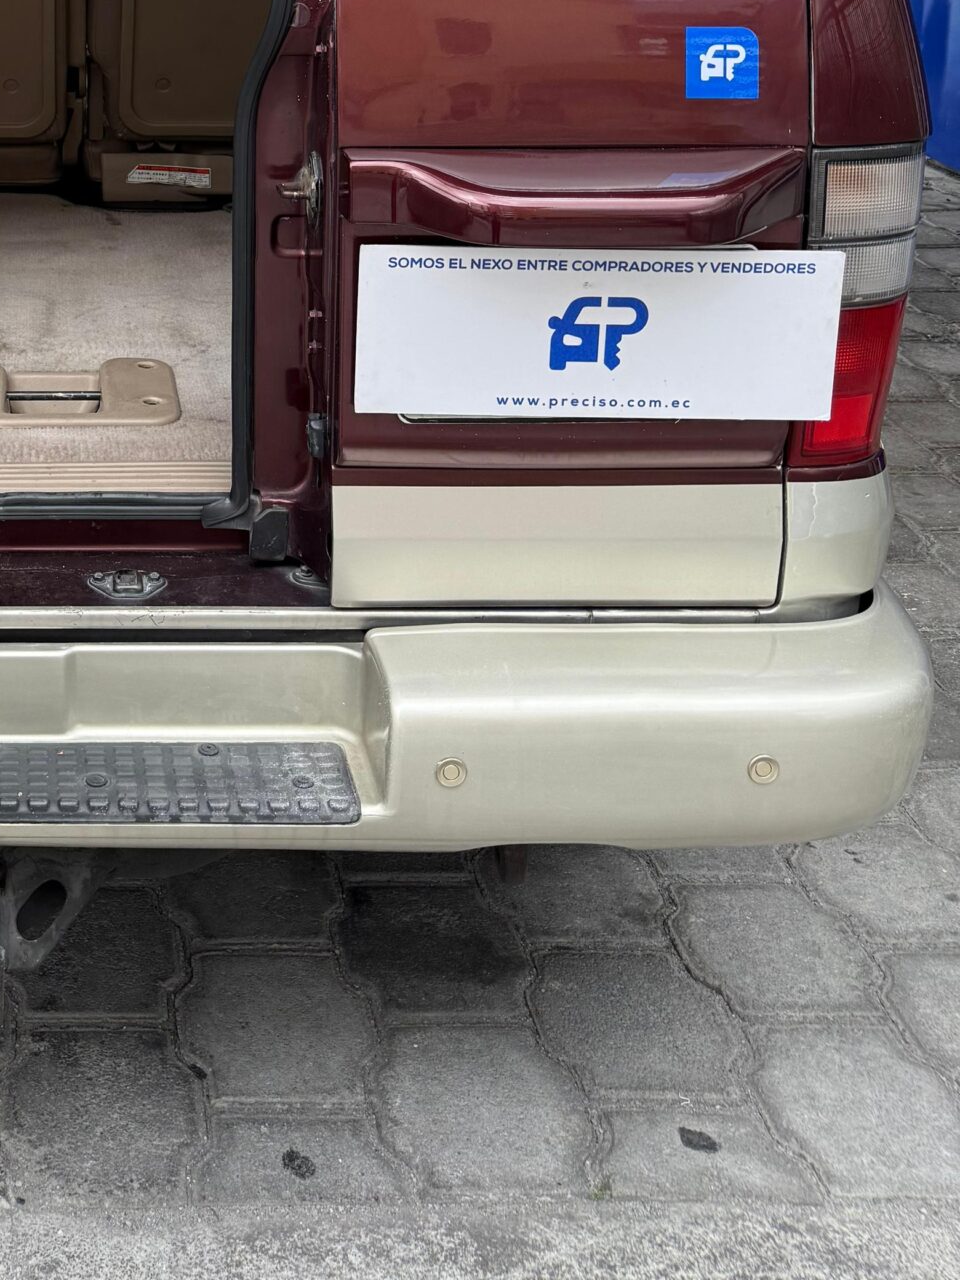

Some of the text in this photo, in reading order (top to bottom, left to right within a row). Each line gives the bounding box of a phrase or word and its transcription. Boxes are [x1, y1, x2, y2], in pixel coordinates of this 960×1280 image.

[387, 256, 817, 274] SOMOS EL NEXO ENTRE COMPRADORES Y VENDEDORES
[496, 395, 691, 410] www.preciso.com.ec
